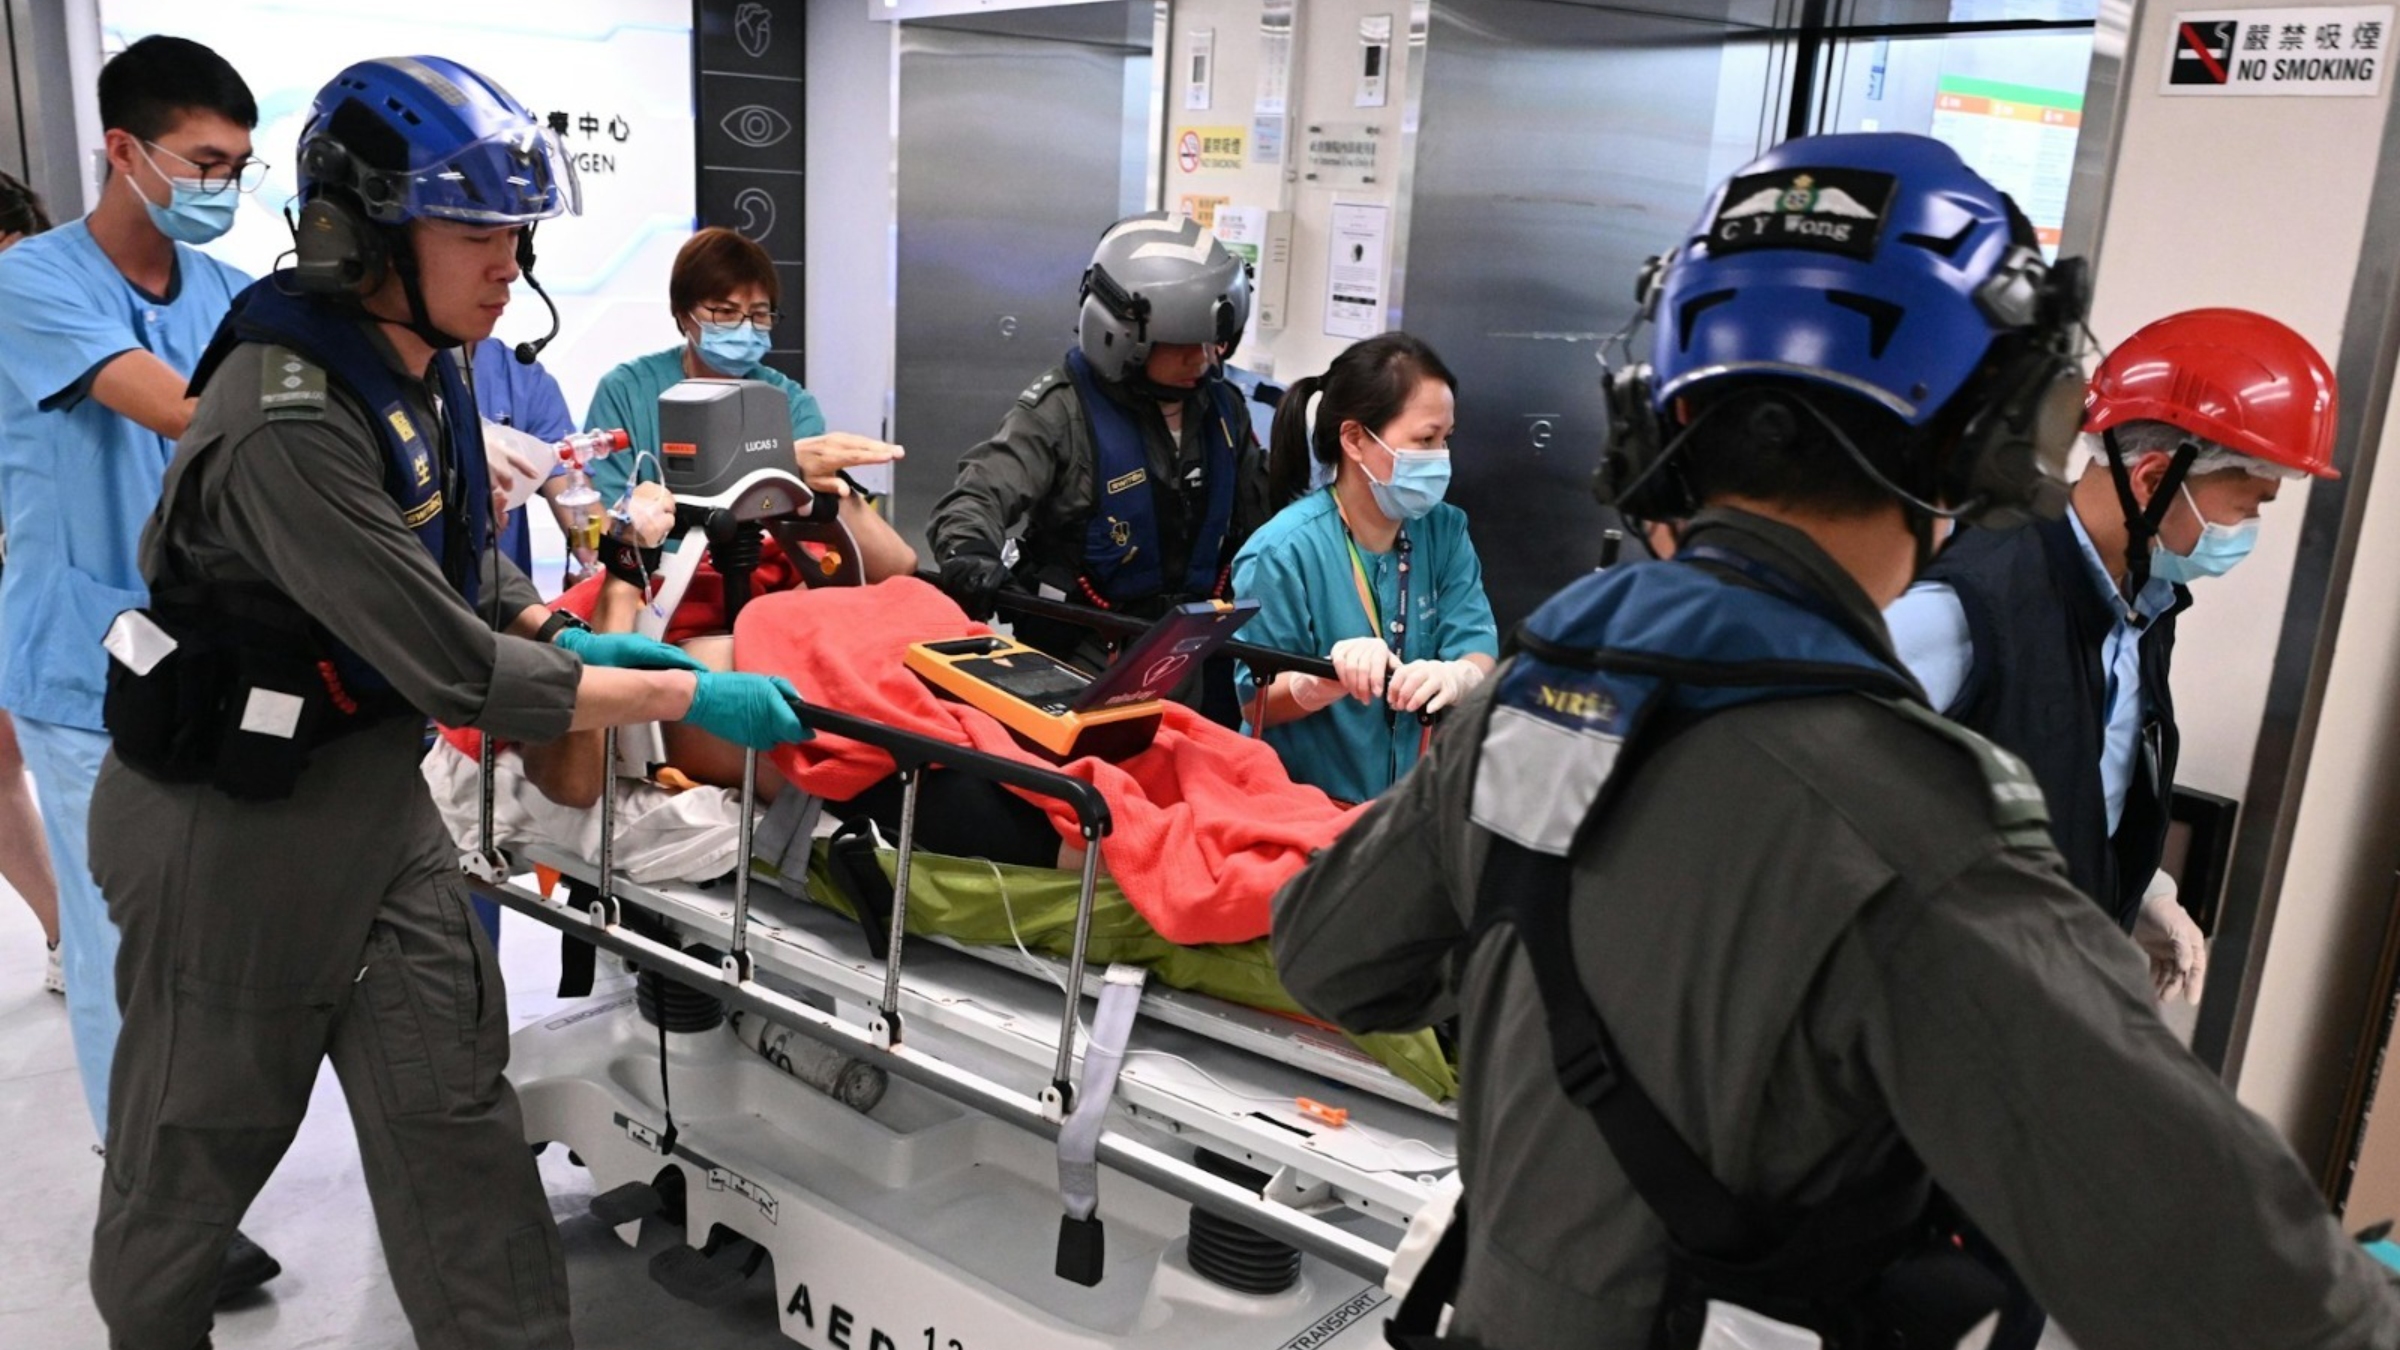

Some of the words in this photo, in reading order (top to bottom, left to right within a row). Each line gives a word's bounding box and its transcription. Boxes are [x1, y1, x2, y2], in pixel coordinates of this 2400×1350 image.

[2242, 22, 2383, 51] 嚴禁吸煙
[2237, 58, 2267, 81] NO
[2272, 57, 2375, 81] SMOKING
[526, 109, 630, 142] 療中心
[1720, 220, 1741, 241] C
[1753, 215, 1771, 235] Y
[1784, 214, 1853, 242] Wong
[745, 440, 771, 453] LUCAS
[772, 438, 778, 449] 3
[1288, 1293, 1377, 1350] TRANSPORT
